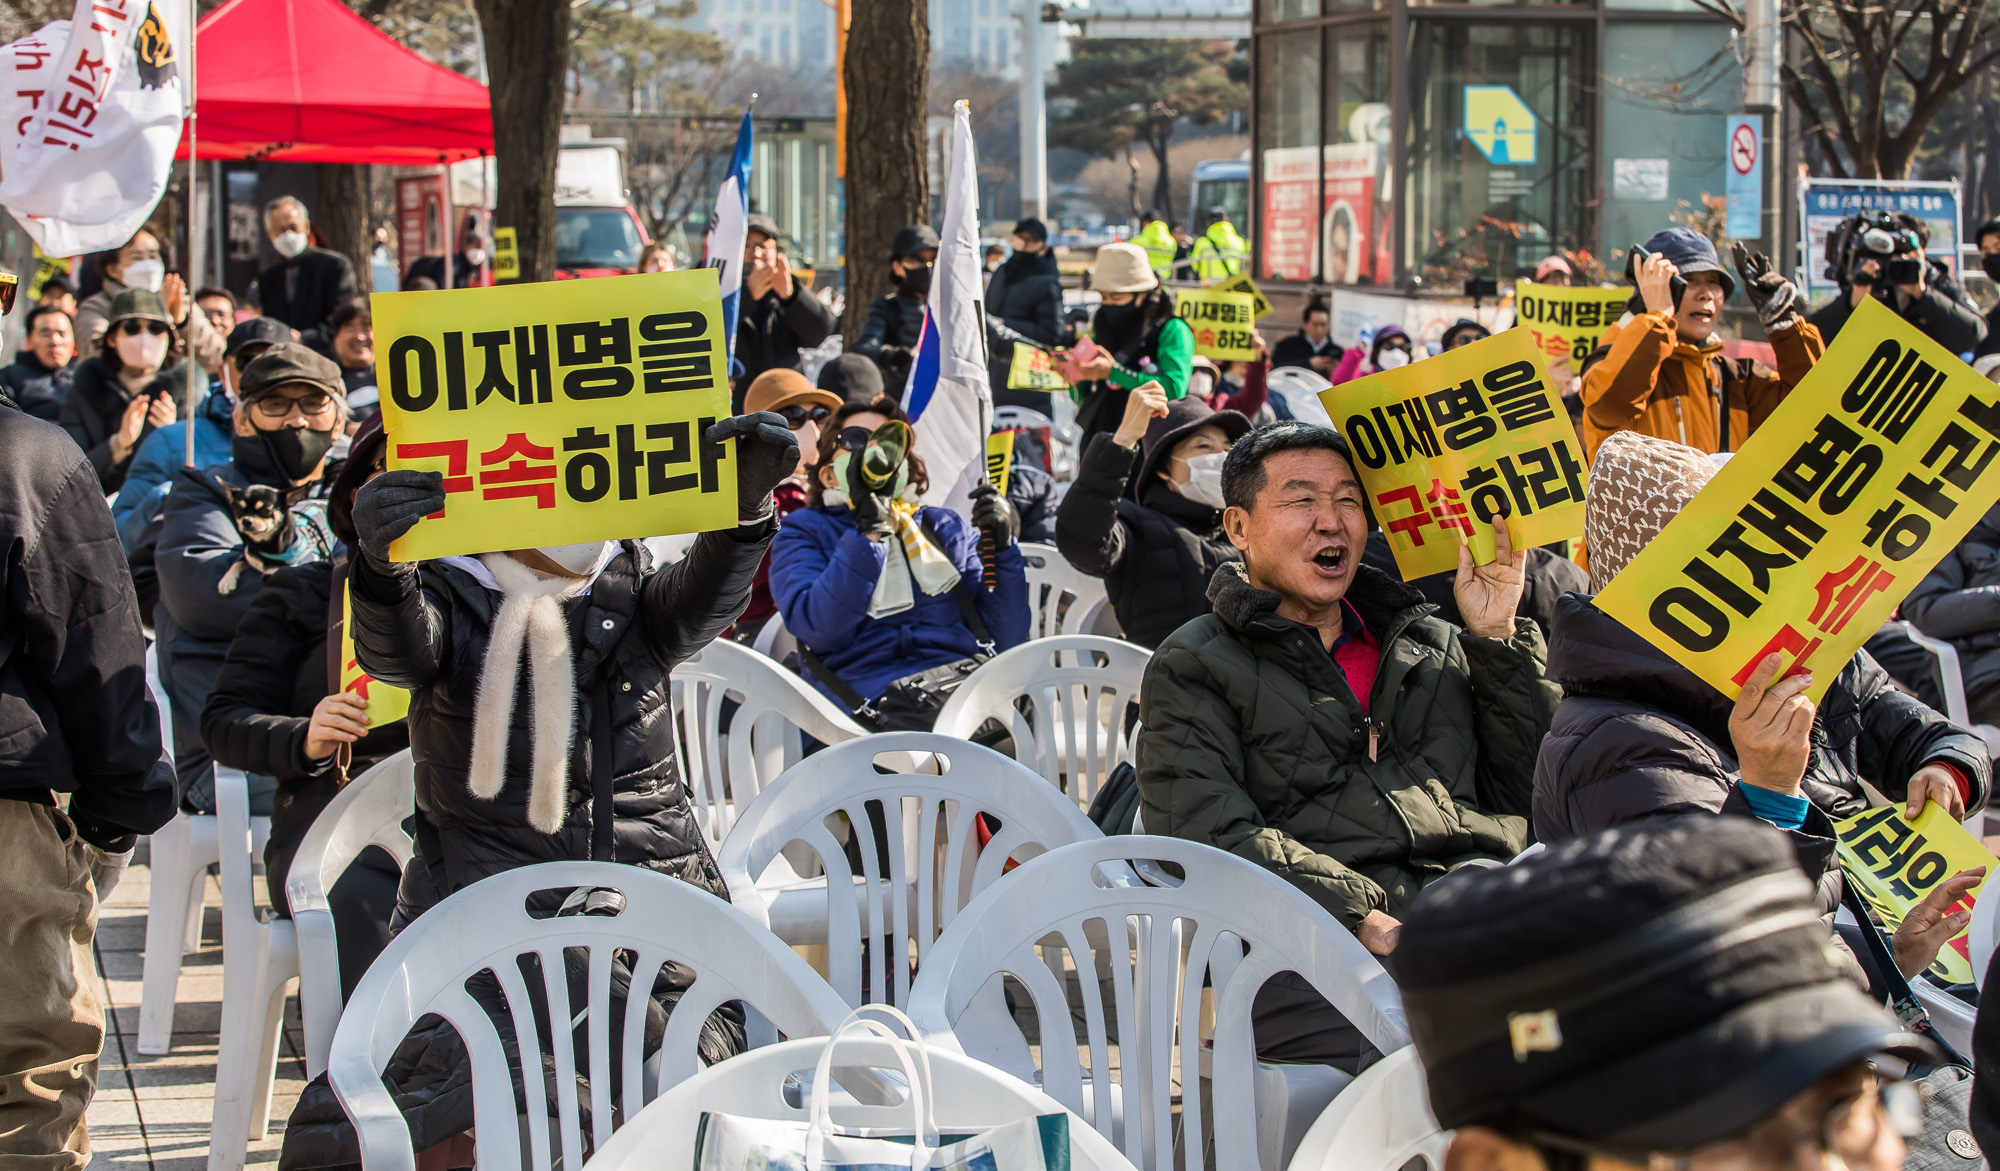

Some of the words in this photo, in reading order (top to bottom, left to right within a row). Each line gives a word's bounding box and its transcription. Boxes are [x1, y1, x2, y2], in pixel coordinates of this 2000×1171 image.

[388, 310, 714, 413] 이재명을
[1181, 302, 1250, 323] 이재명을
[1521, 296, 1627, 327] 이재명을
[1345, 361, 1555, 470] 이재명을
[396, 416, 727, 520] 구속하라
[1376, 440, 1586, 547] 구속하라
[1648, 338, 1949, 653] 이재명을
